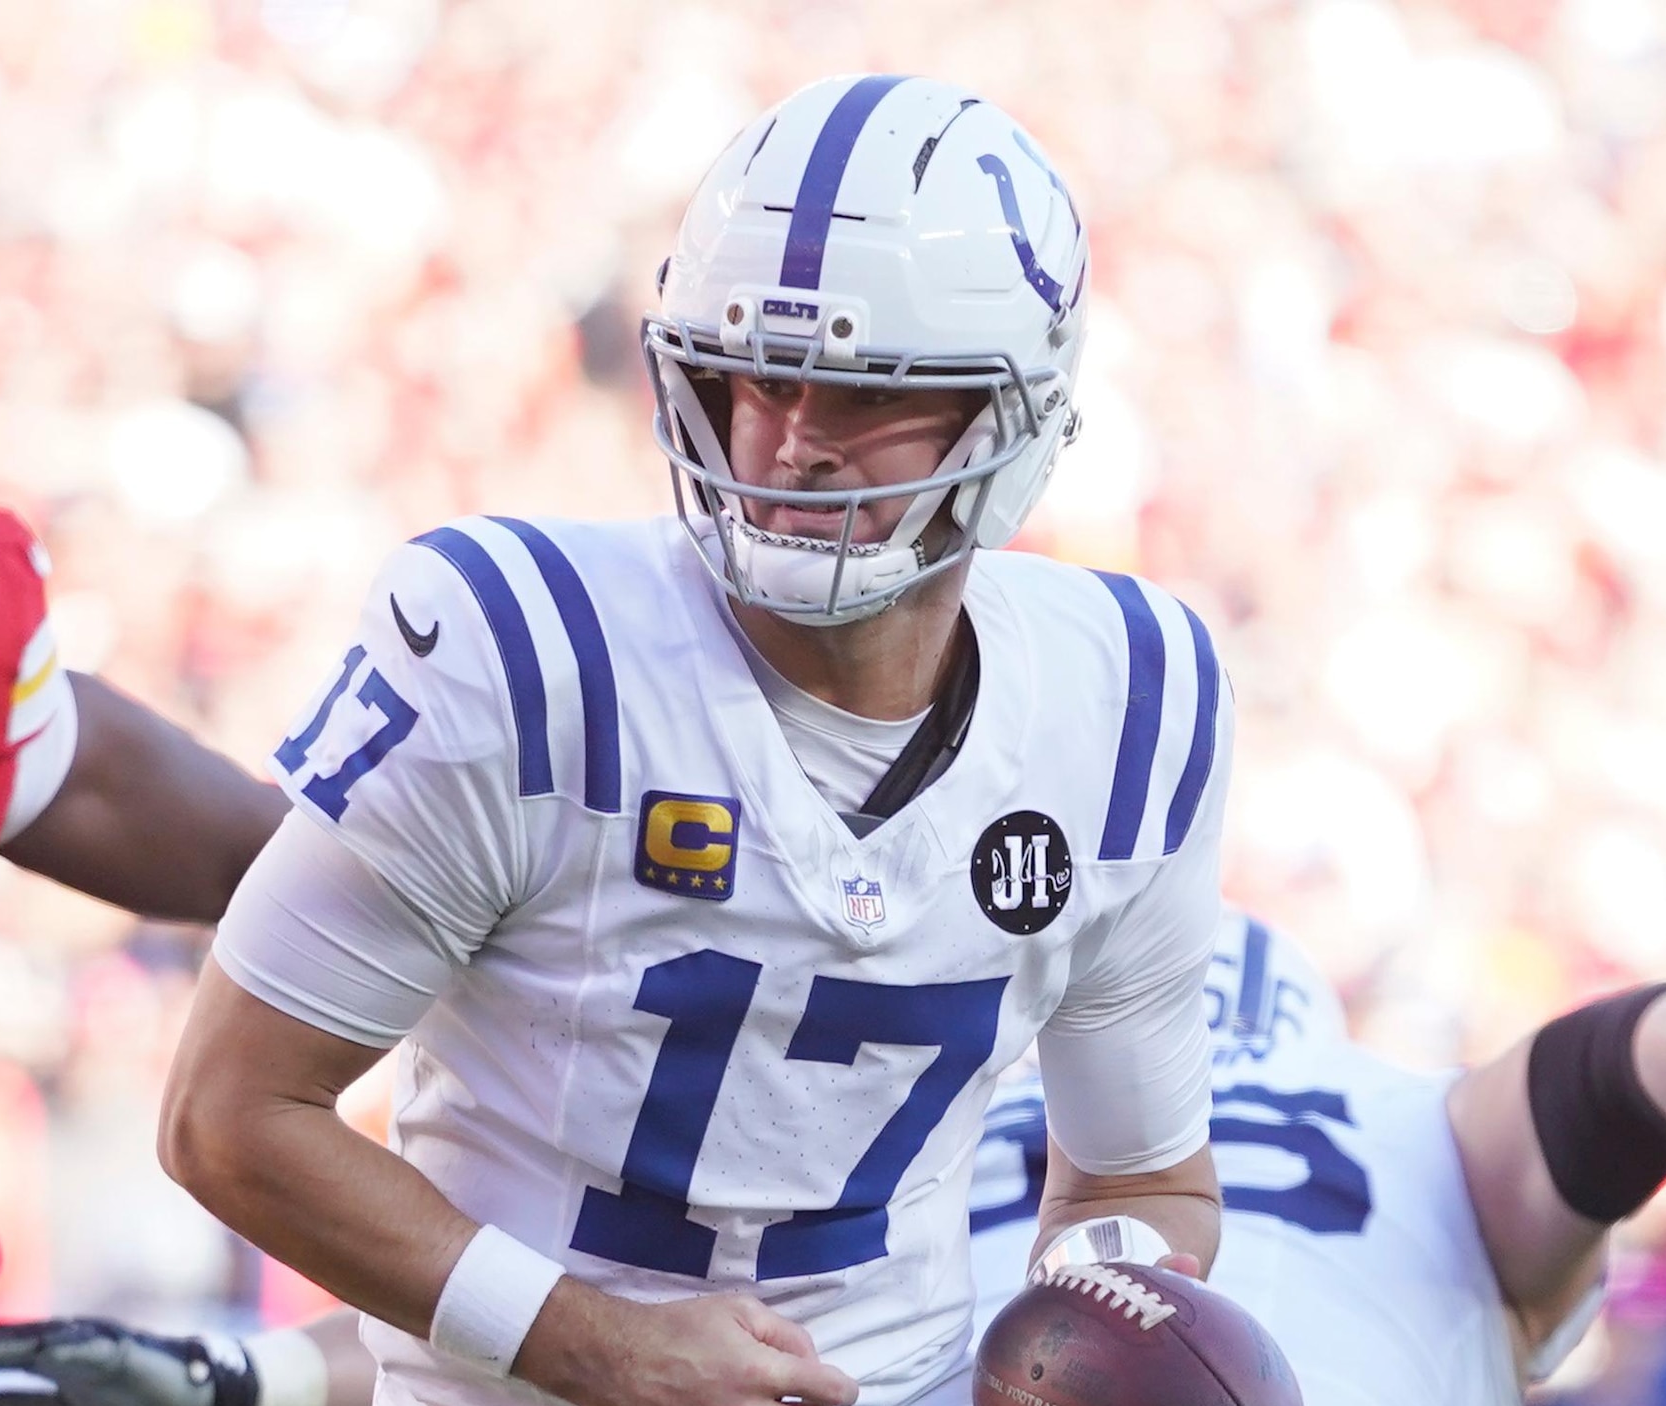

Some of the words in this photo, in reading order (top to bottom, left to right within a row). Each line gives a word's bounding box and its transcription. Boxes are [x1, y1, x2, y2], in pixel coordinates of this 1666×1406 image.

[762, 299, 819, 320] COLTS
[273, 643, 421, 824] 17
[645, 799, 733, 872] C
[850, 896, 882, 920] NFL
[568, 948, 1015, 1281] 17
